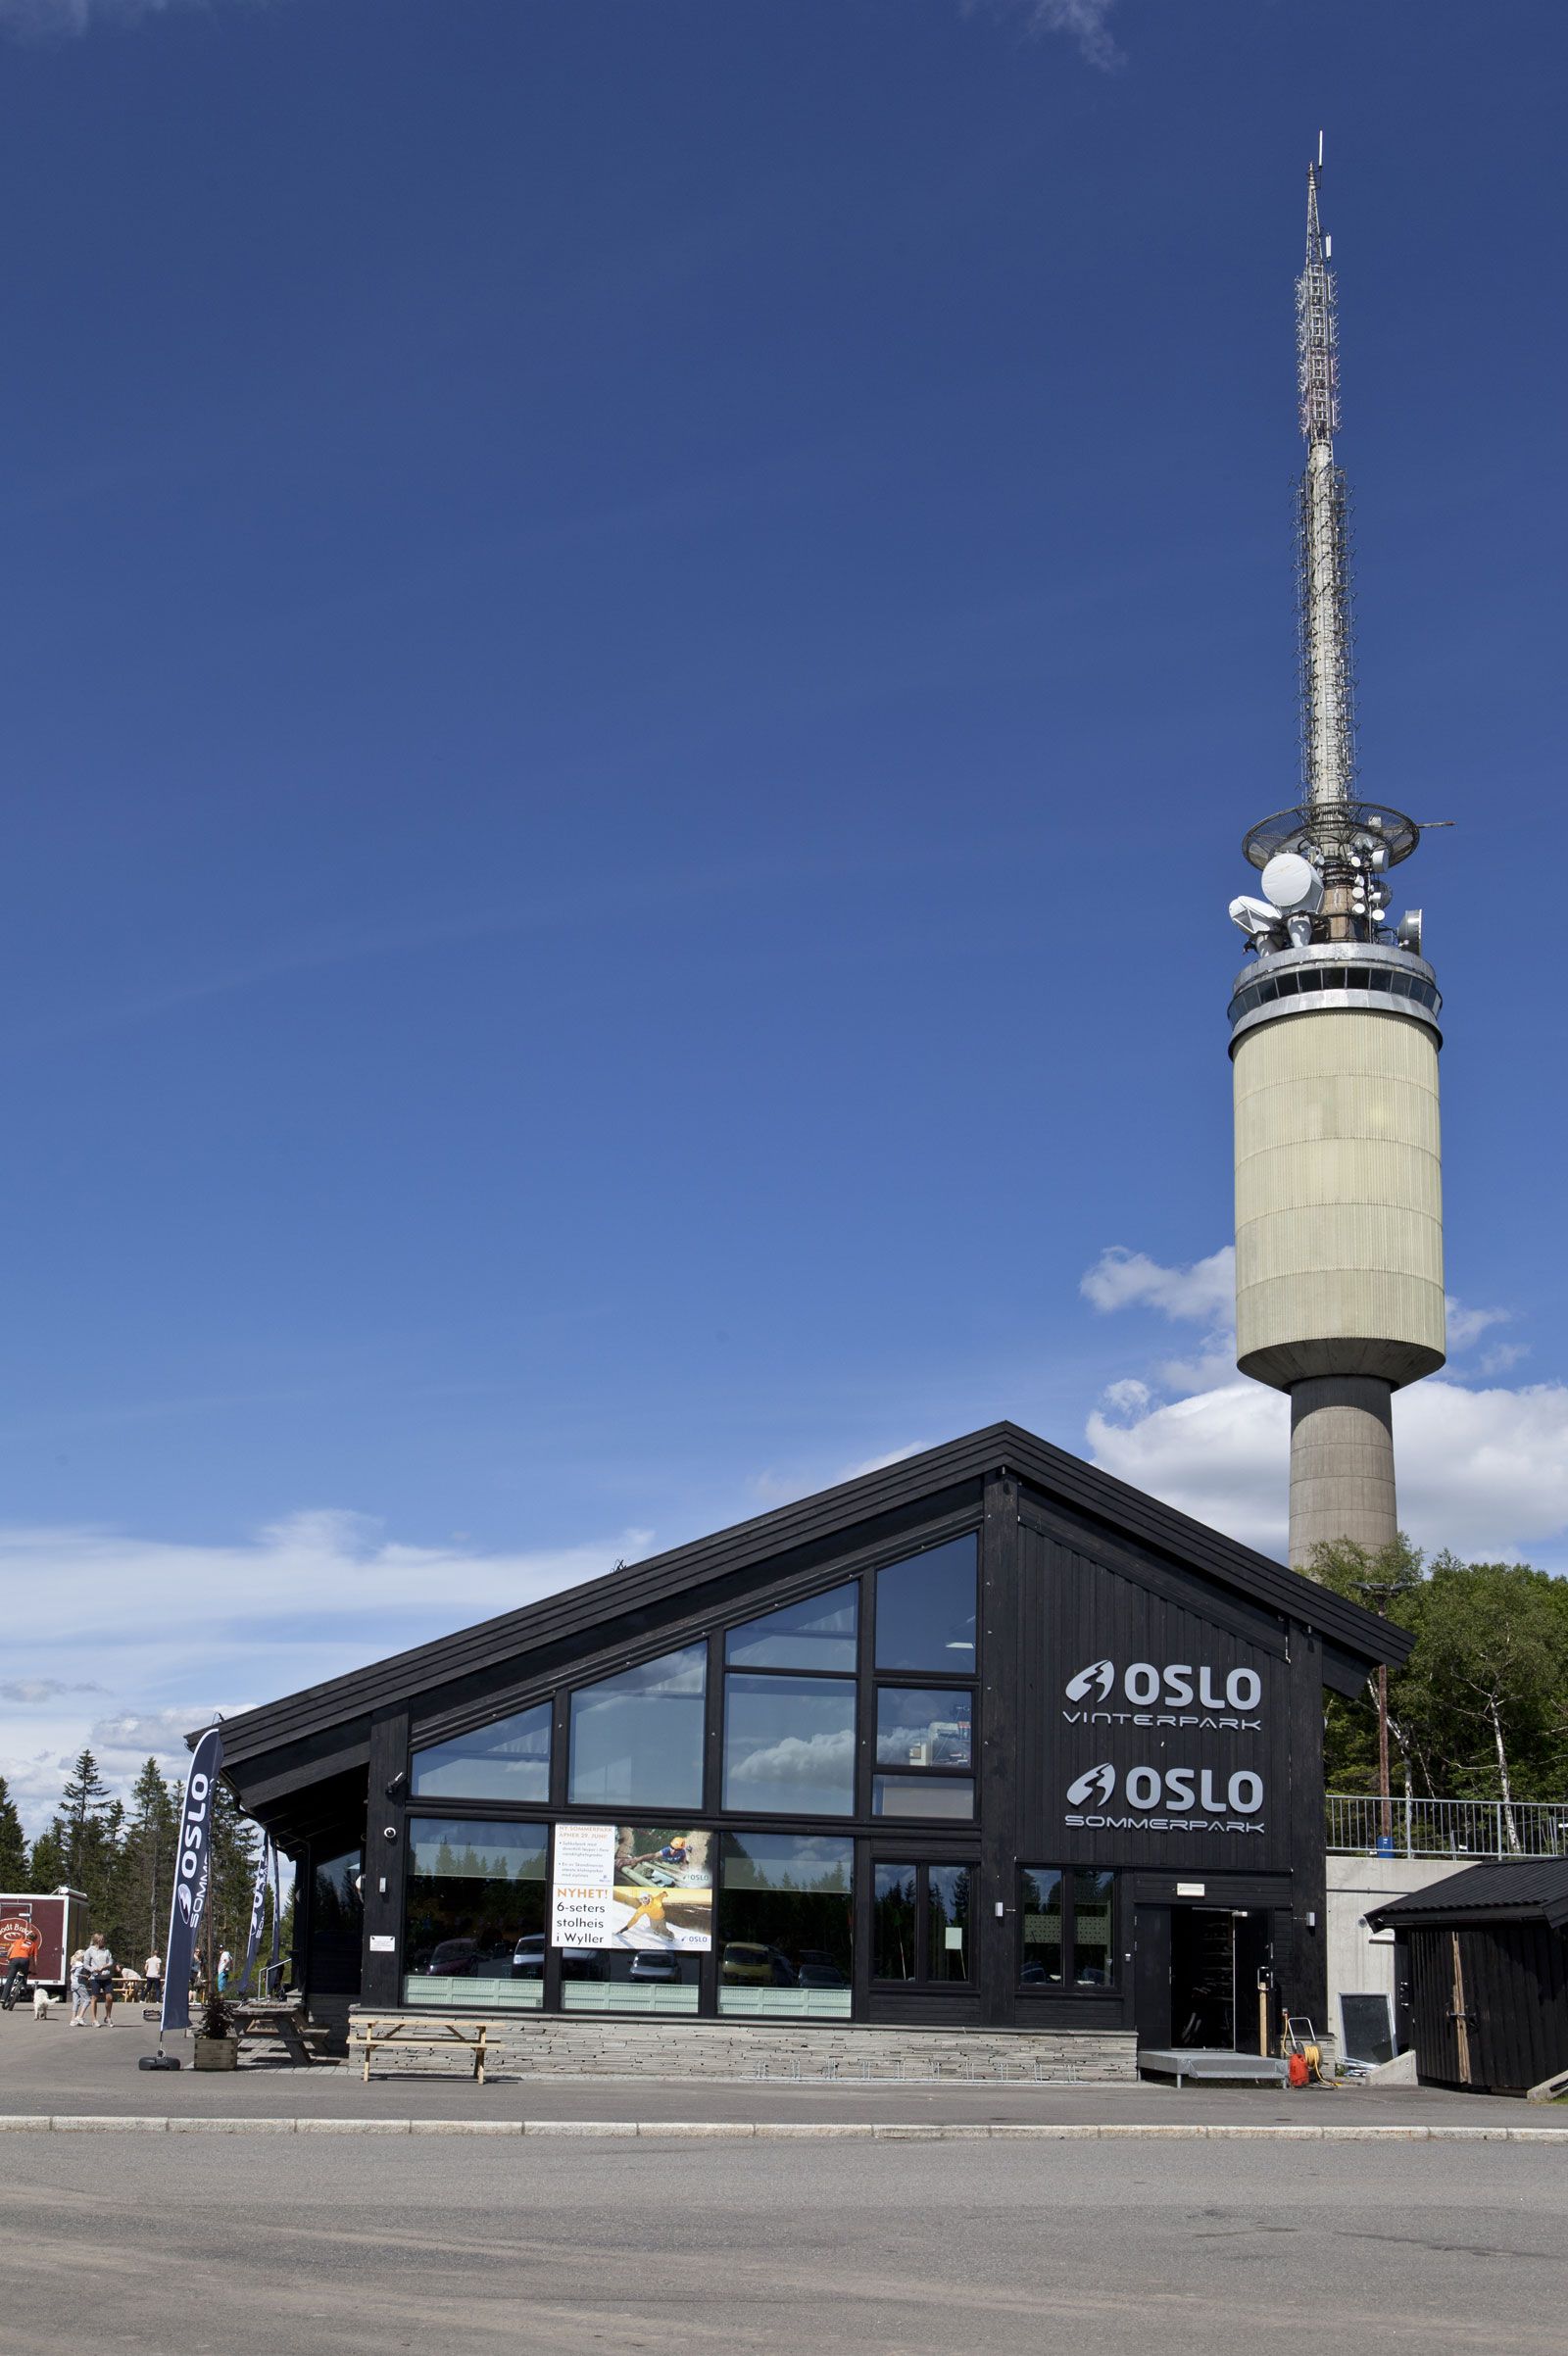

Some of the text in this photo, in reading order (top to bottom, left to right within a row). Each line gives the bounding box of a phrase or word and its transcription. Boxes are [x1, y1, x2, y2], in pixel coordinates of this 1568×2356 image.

[1124, 1662, 1261, 1711] OSLO
[1062, 1711, 1261, 1731] VINTERPARK
[1125, 1766, 1264, 1813] OSLO
[181, 1773, 209, 1879] OSLO
[1064, 1815, 1265, 1834] SOMMERPARK
[557, 1889, 608, 1899] NYHET!
[557, 1902, 606, 1913] 6-seters
[556, 1917, 604, 1929] stolheis
[556, 1933, 605, 1945] i Wyller
